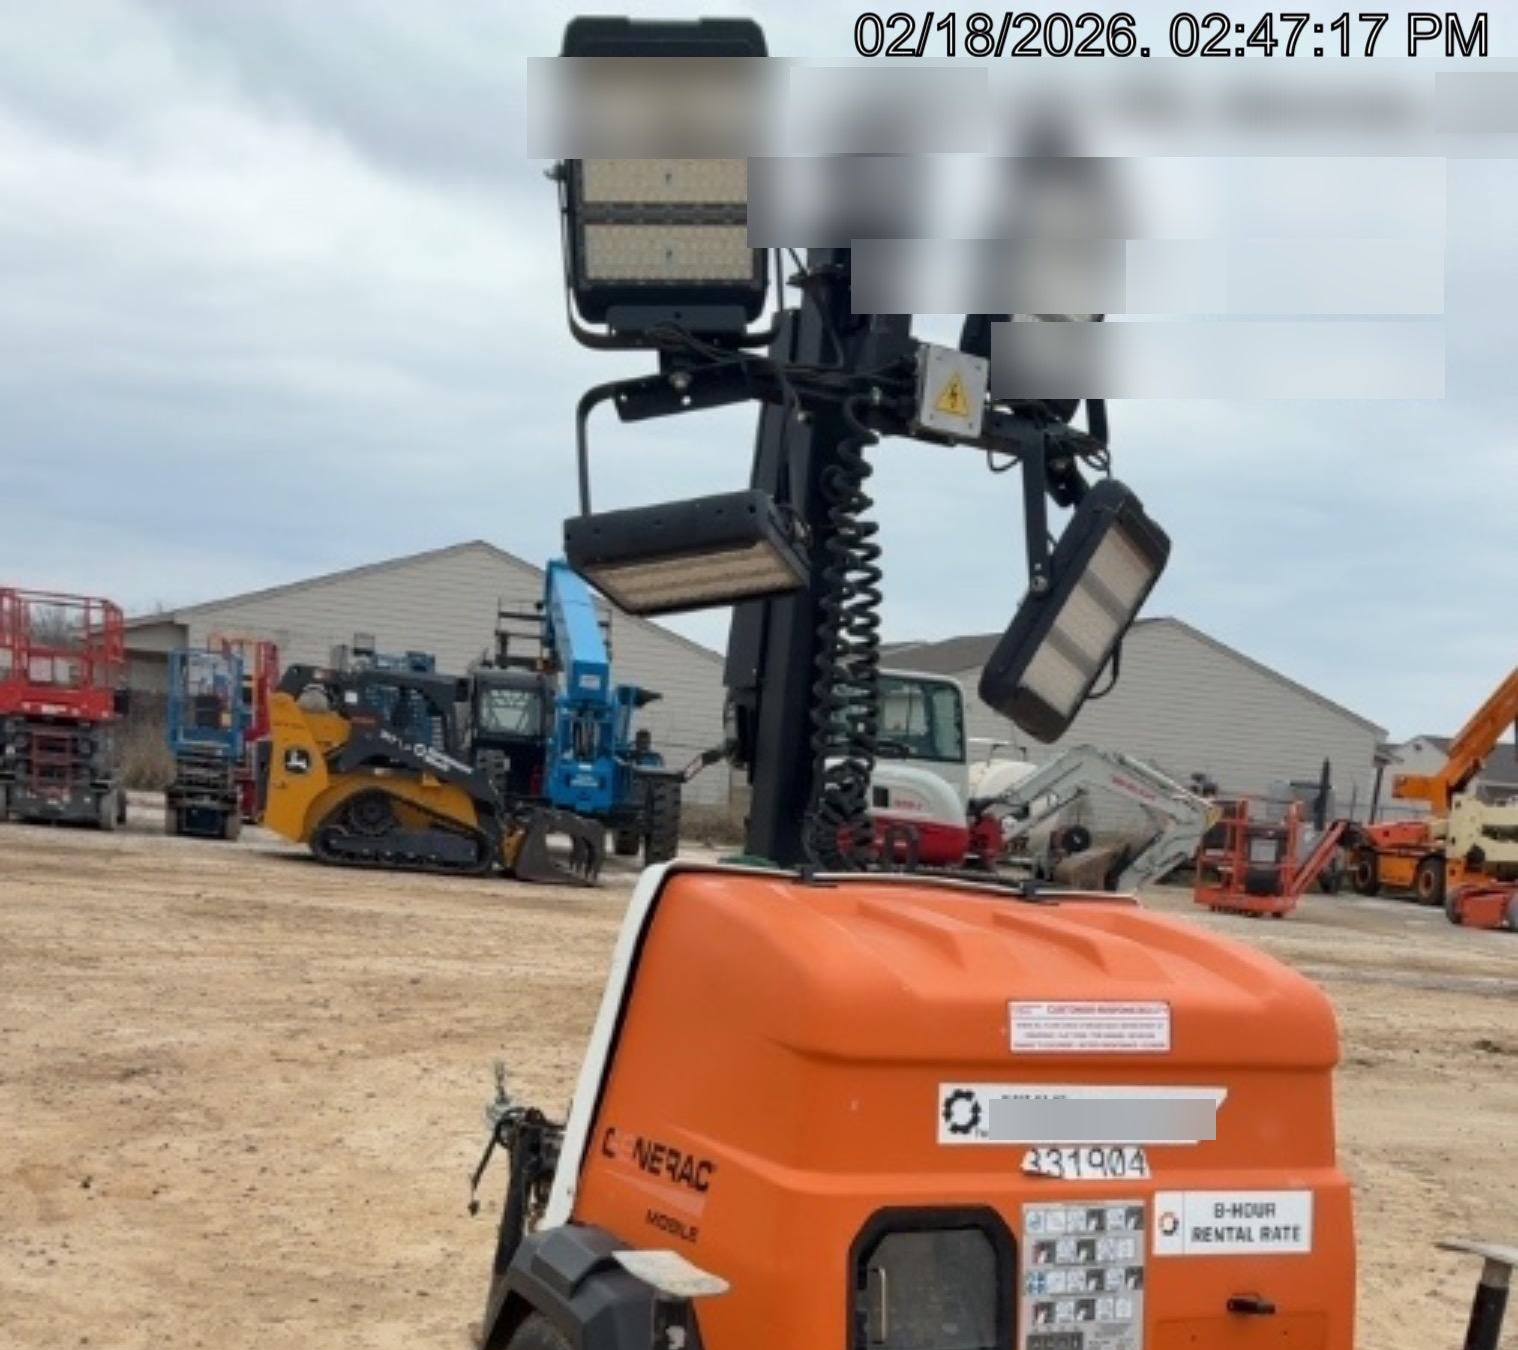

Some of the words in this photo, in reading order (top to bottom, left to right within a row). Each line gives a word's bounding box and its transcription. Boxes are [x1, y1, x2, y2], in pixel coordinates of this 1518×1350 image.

[646, 1208, 699, 1243] MOBILE
[1191, 1225, 1256, 1243] RENTAL
[1259, 1224, 1303, 1243] RATE
